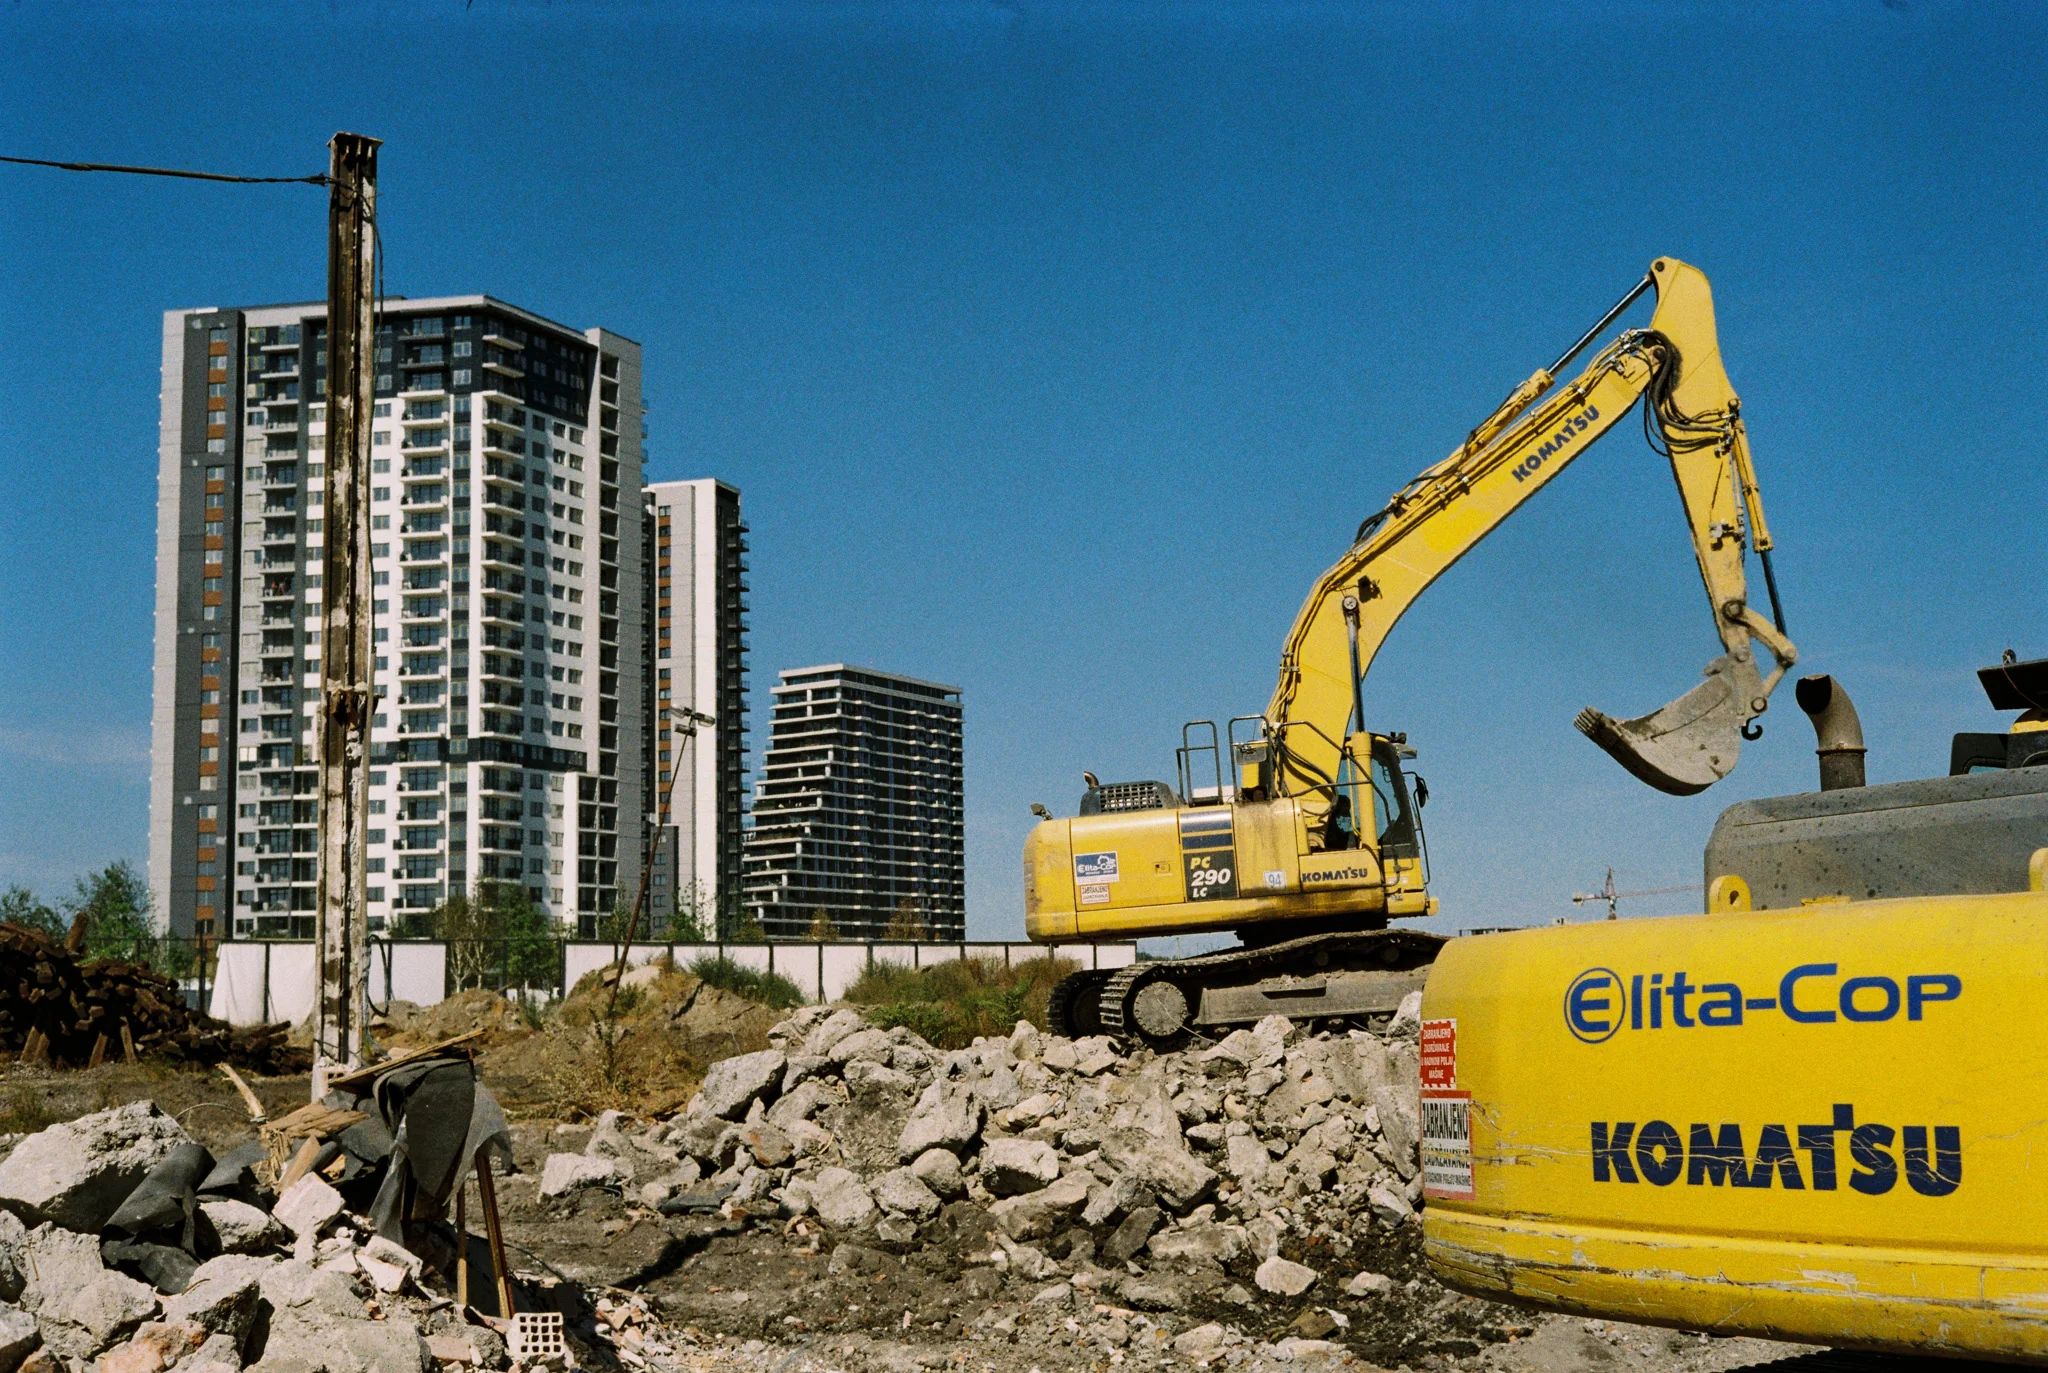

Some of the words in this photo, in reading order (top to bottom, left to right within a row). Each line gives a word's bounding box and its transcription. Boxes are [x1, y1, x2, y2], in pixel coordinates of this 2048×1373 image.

[1512, 405, 1600, 482] KOMATSU
[1190, 856, 1211, 869] PC
[1191, 868, 1231, 886] 290
[1302, 867, 1368, 882] KOMATSU
[1192, 887, 1208, 898] LC
[1423, 1028, 1451, 1039] ZABRANJENO
[1440, 1056, 1454, 1066] POLJU
[1422, 1102, 1468, 1140] ZABRANJENO
[1590, 1103, 1963, 1197] KOMATSU
